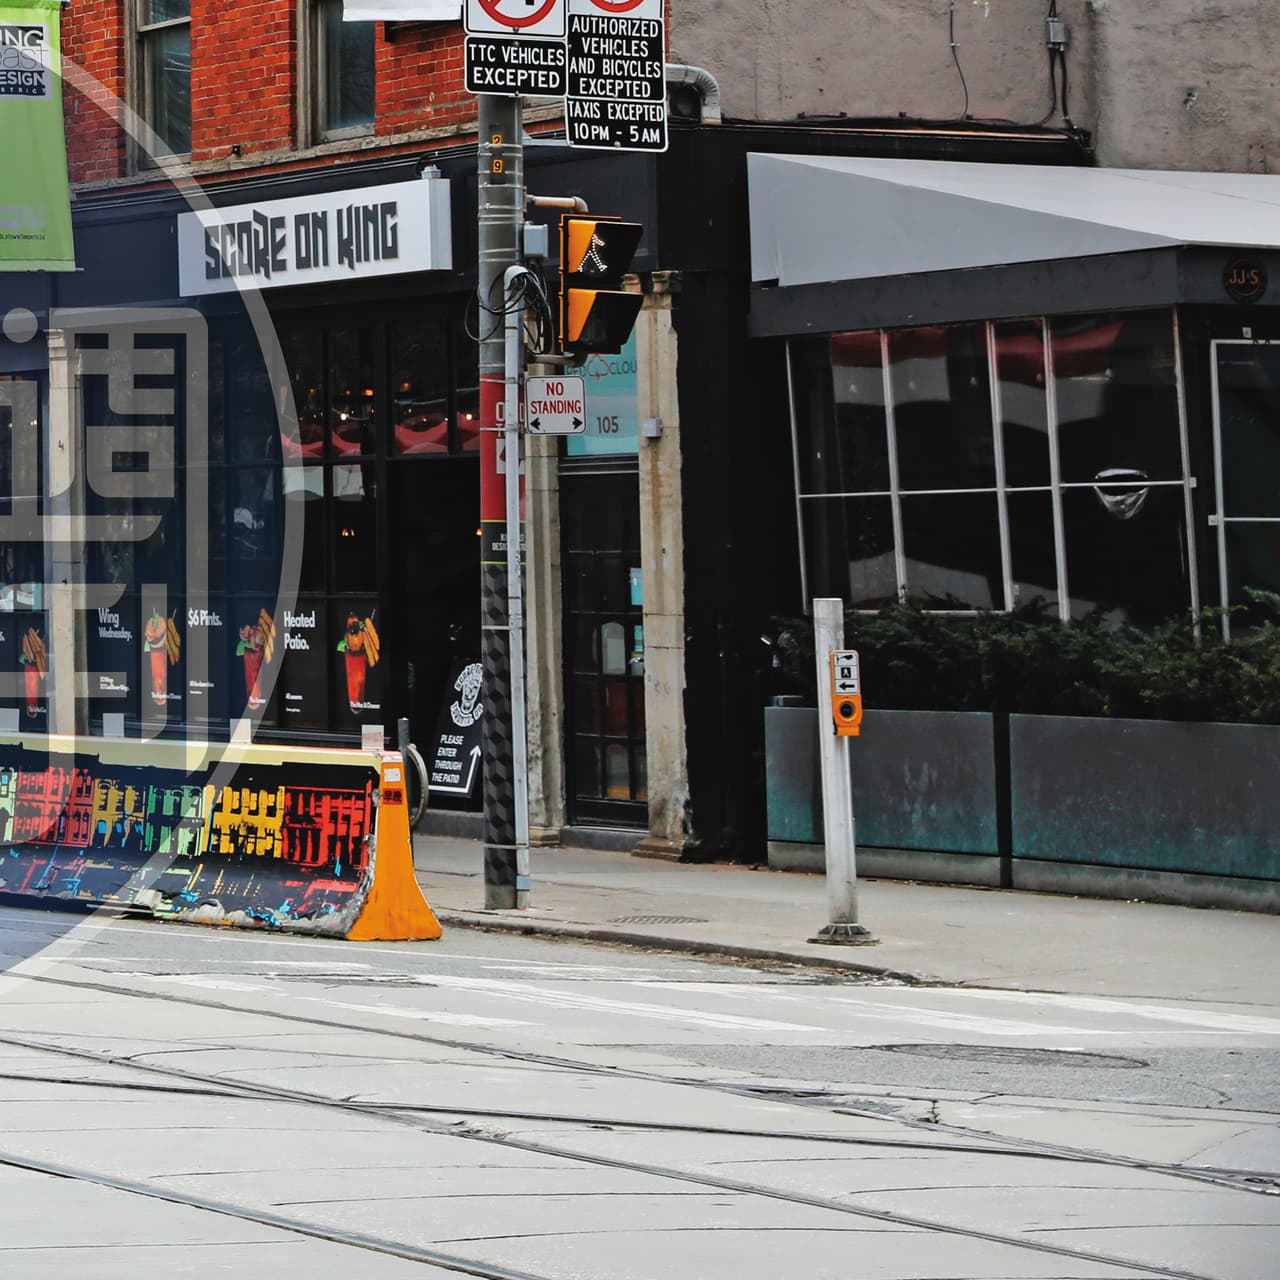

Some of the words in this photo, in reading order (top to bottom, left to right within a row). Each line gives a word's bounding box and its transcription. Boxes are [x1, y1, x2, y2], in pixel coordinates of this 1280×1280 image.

[572, 17, 658, 37] AUTHORIZED
[469, 44, 496, 62] TTC
[501, 45, 565, 66] VEHICLES
[582, 37, 649, 58] VEHICLES
[473, 67, 560, 89] EXCEPTED
[570, 58, 595, 75] AND
[602, 59, 661, 79] BICYCLES
[579, 78, 651, 98] EXCEPTED
[568, 101, 601, 118] TAXIS
[608, 103, 664, 122] EXCEPTED
[204, 209, 288, 280] SCORE
[294, 210, 329, 270] ON
[336, 201, 400, 270] KING
[546, 382, 564, 396] NO
[530, 400, 581, 415] STANDING
[597, 416, 619, 433] 105
[98, 607, 120, 628] Wing
[188, 609, 199, 628] $6
[200, 609, 223, 626] Pints.
[283, 610, 315, 629] Heated
[98, 627, 133, 643] Wednesday.
[284, 633, 310, 651] Patio.
[440, 734, 465, 745] PLEASE
[437, 747, 458, 758] ENTER
[434, 759, 463, 771] THROUGH
[432, 772, 444, 782] THE
[444, 773, 461, 784] PATIO
